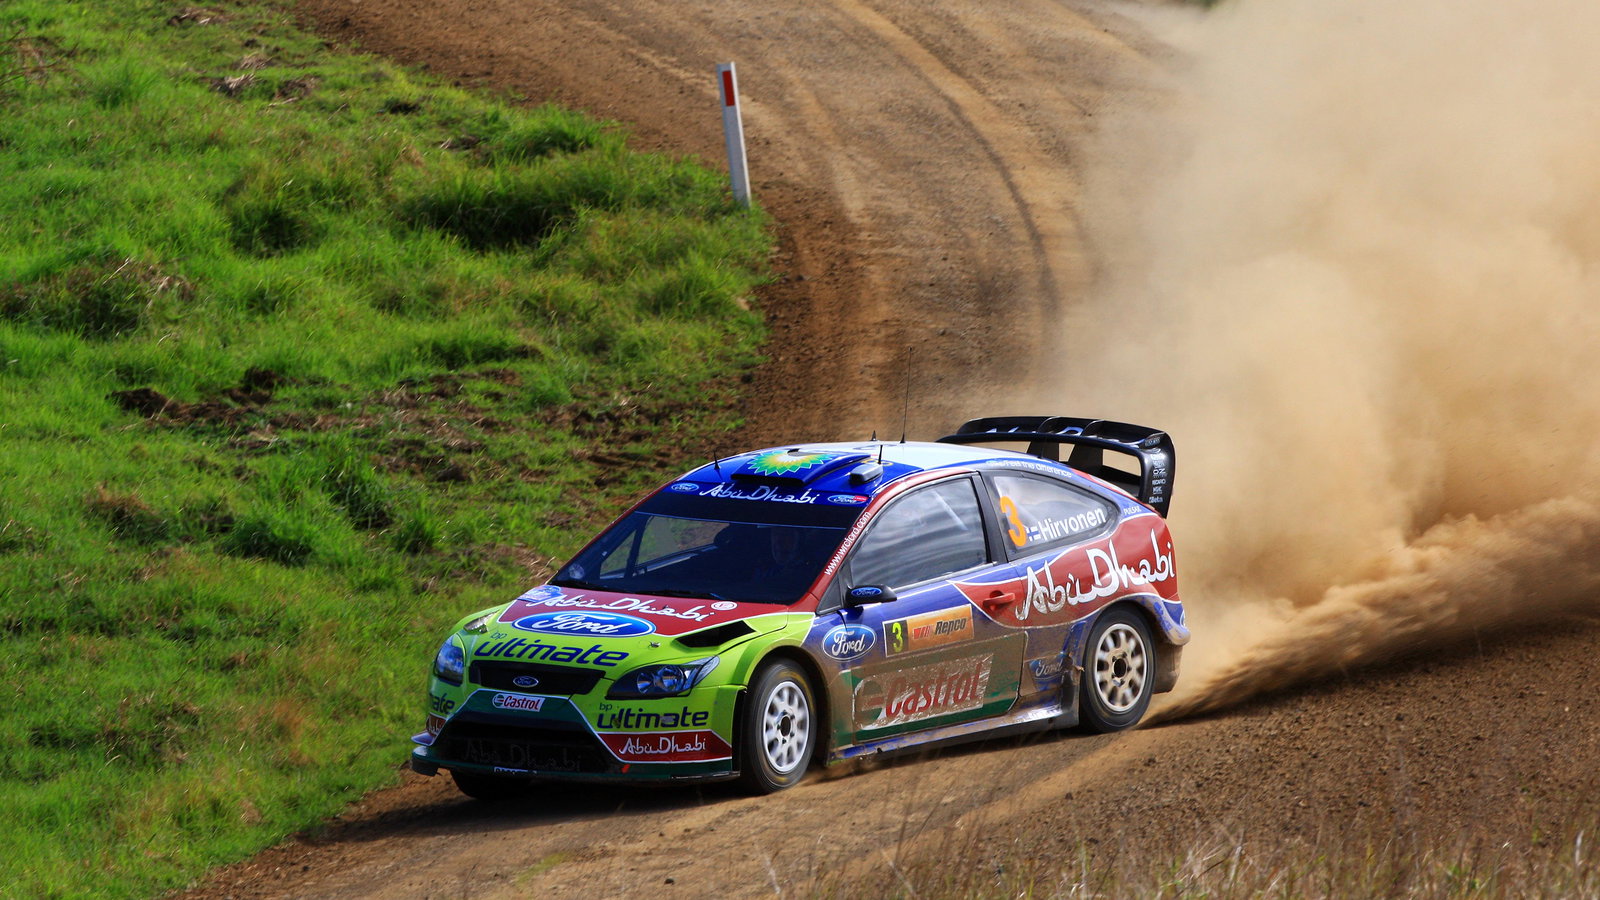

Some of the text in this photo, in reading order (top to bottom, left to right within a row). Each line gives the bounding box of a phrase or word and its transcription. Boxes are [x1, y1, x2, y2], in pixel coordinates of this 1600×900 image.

[699, 482, 820, 504] Abu Dhabi
[1000, 496, 1106, 547] 3 Hirvonen
[824, 512, 871, 575] www.wrcford.com
[1015, 528, 1175, 620] Abu Dhabi
[526, 594, 714, 622] Abu Dhabi
[490, 631, 507, 640] bp
[532, 613, 633, 634] Ford
[892, 618, 967, 653] 3 Repco
[474, 638, 630, 667] ultimate
[831, 630, 866, 656] Ford
[503, 695, 541, 710] Castrol
[886, 661, 983, 718] Castrol
[597, 706, 709, 729] ultimate
[600, 703, 612, 711] bp
[619, 734, 706, 755] Abu Dhabi
